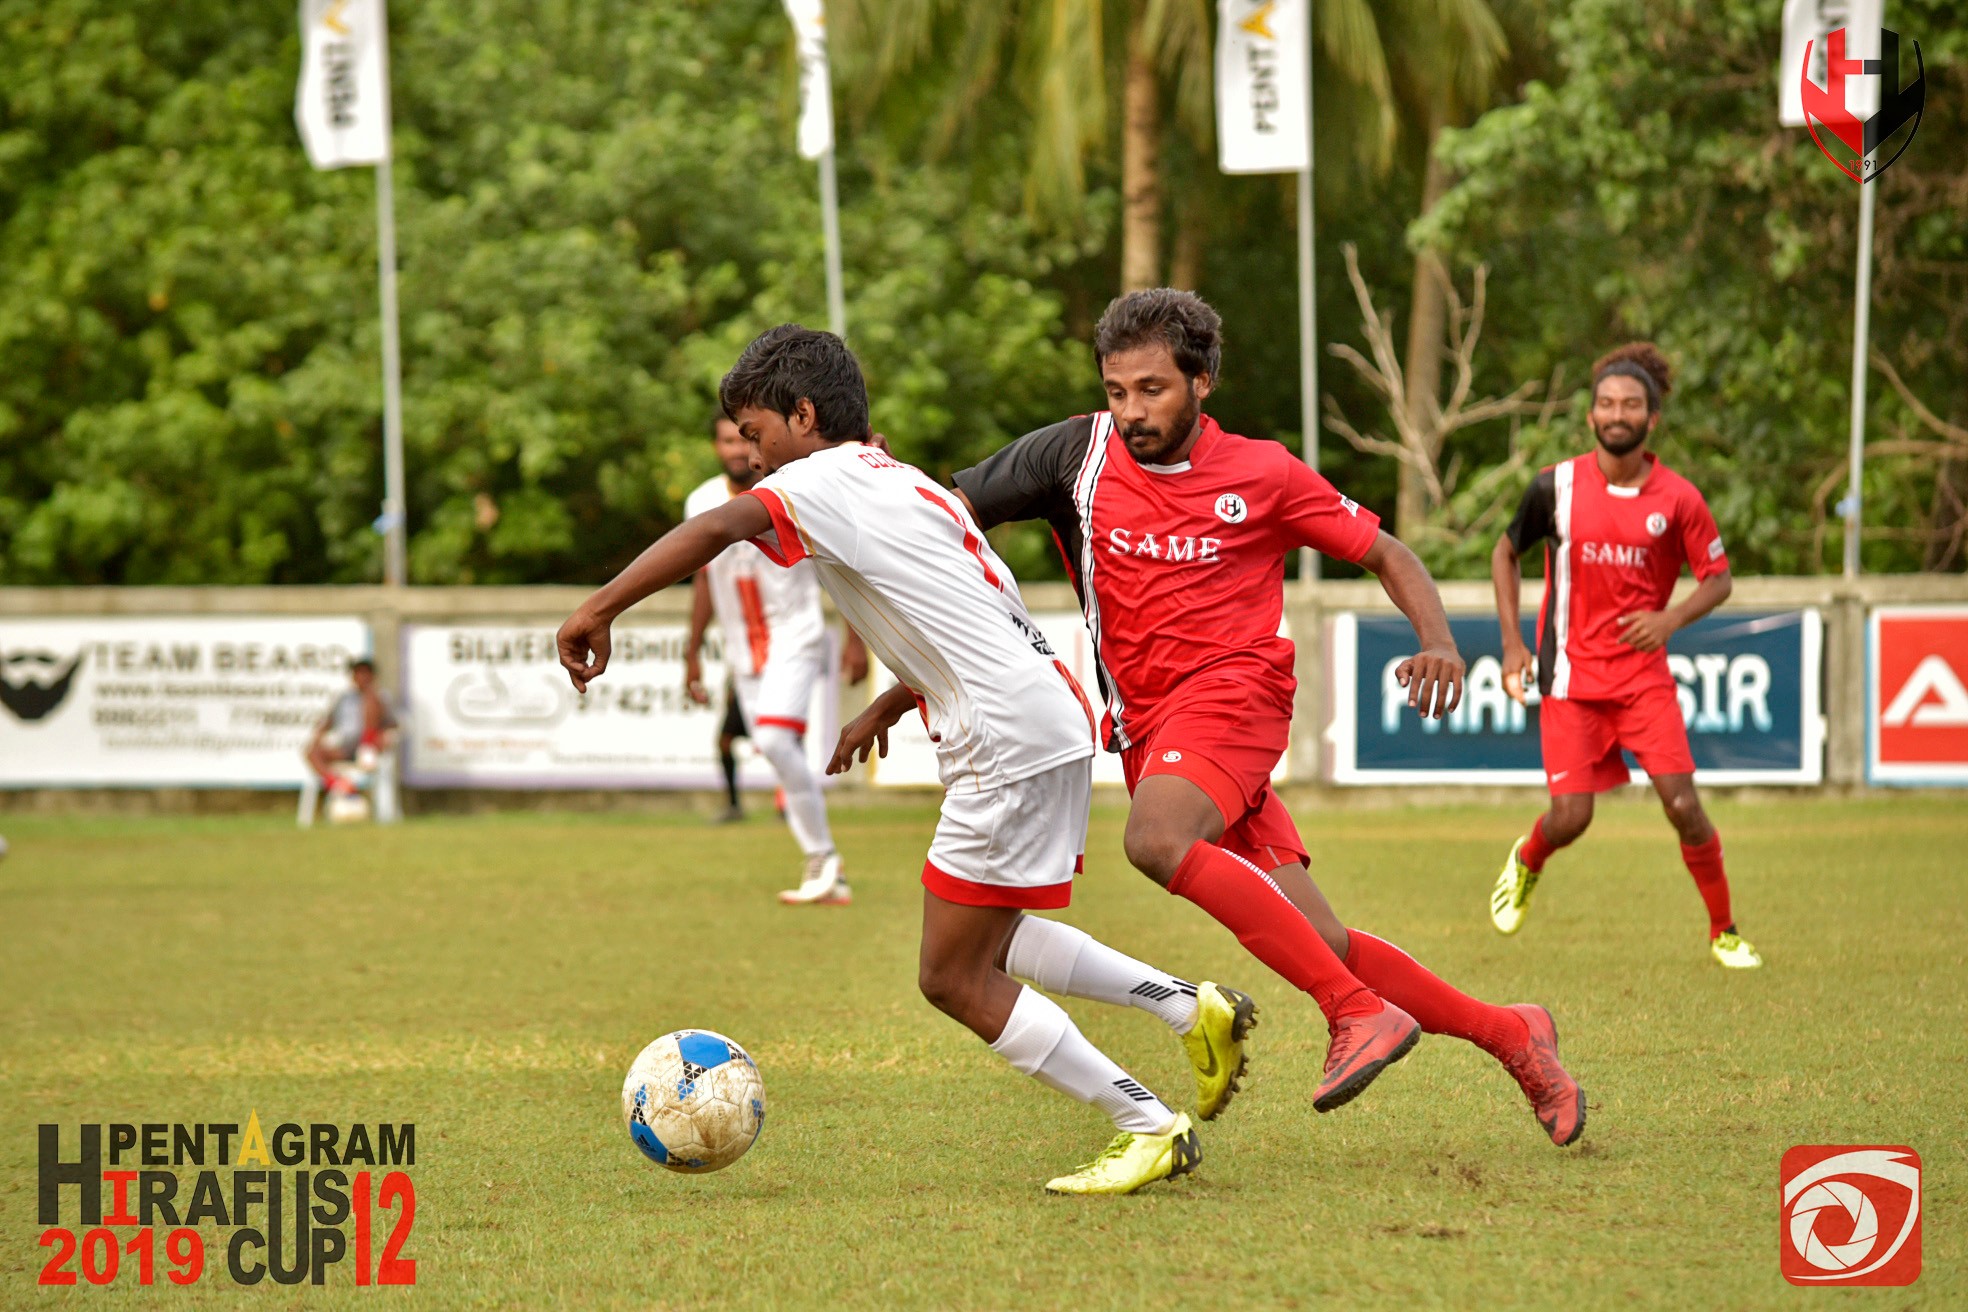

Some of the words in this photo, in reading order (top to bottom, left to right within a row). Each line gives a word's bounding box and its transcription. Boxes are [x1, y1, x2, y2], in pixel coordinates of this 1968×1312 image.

[1107, 527, 1222, 563] SAME
[1581, 541, 1648, 568] SAME
[91, 640, 200, 672] TEAM
[211, 641, 349, 673] BEARD
